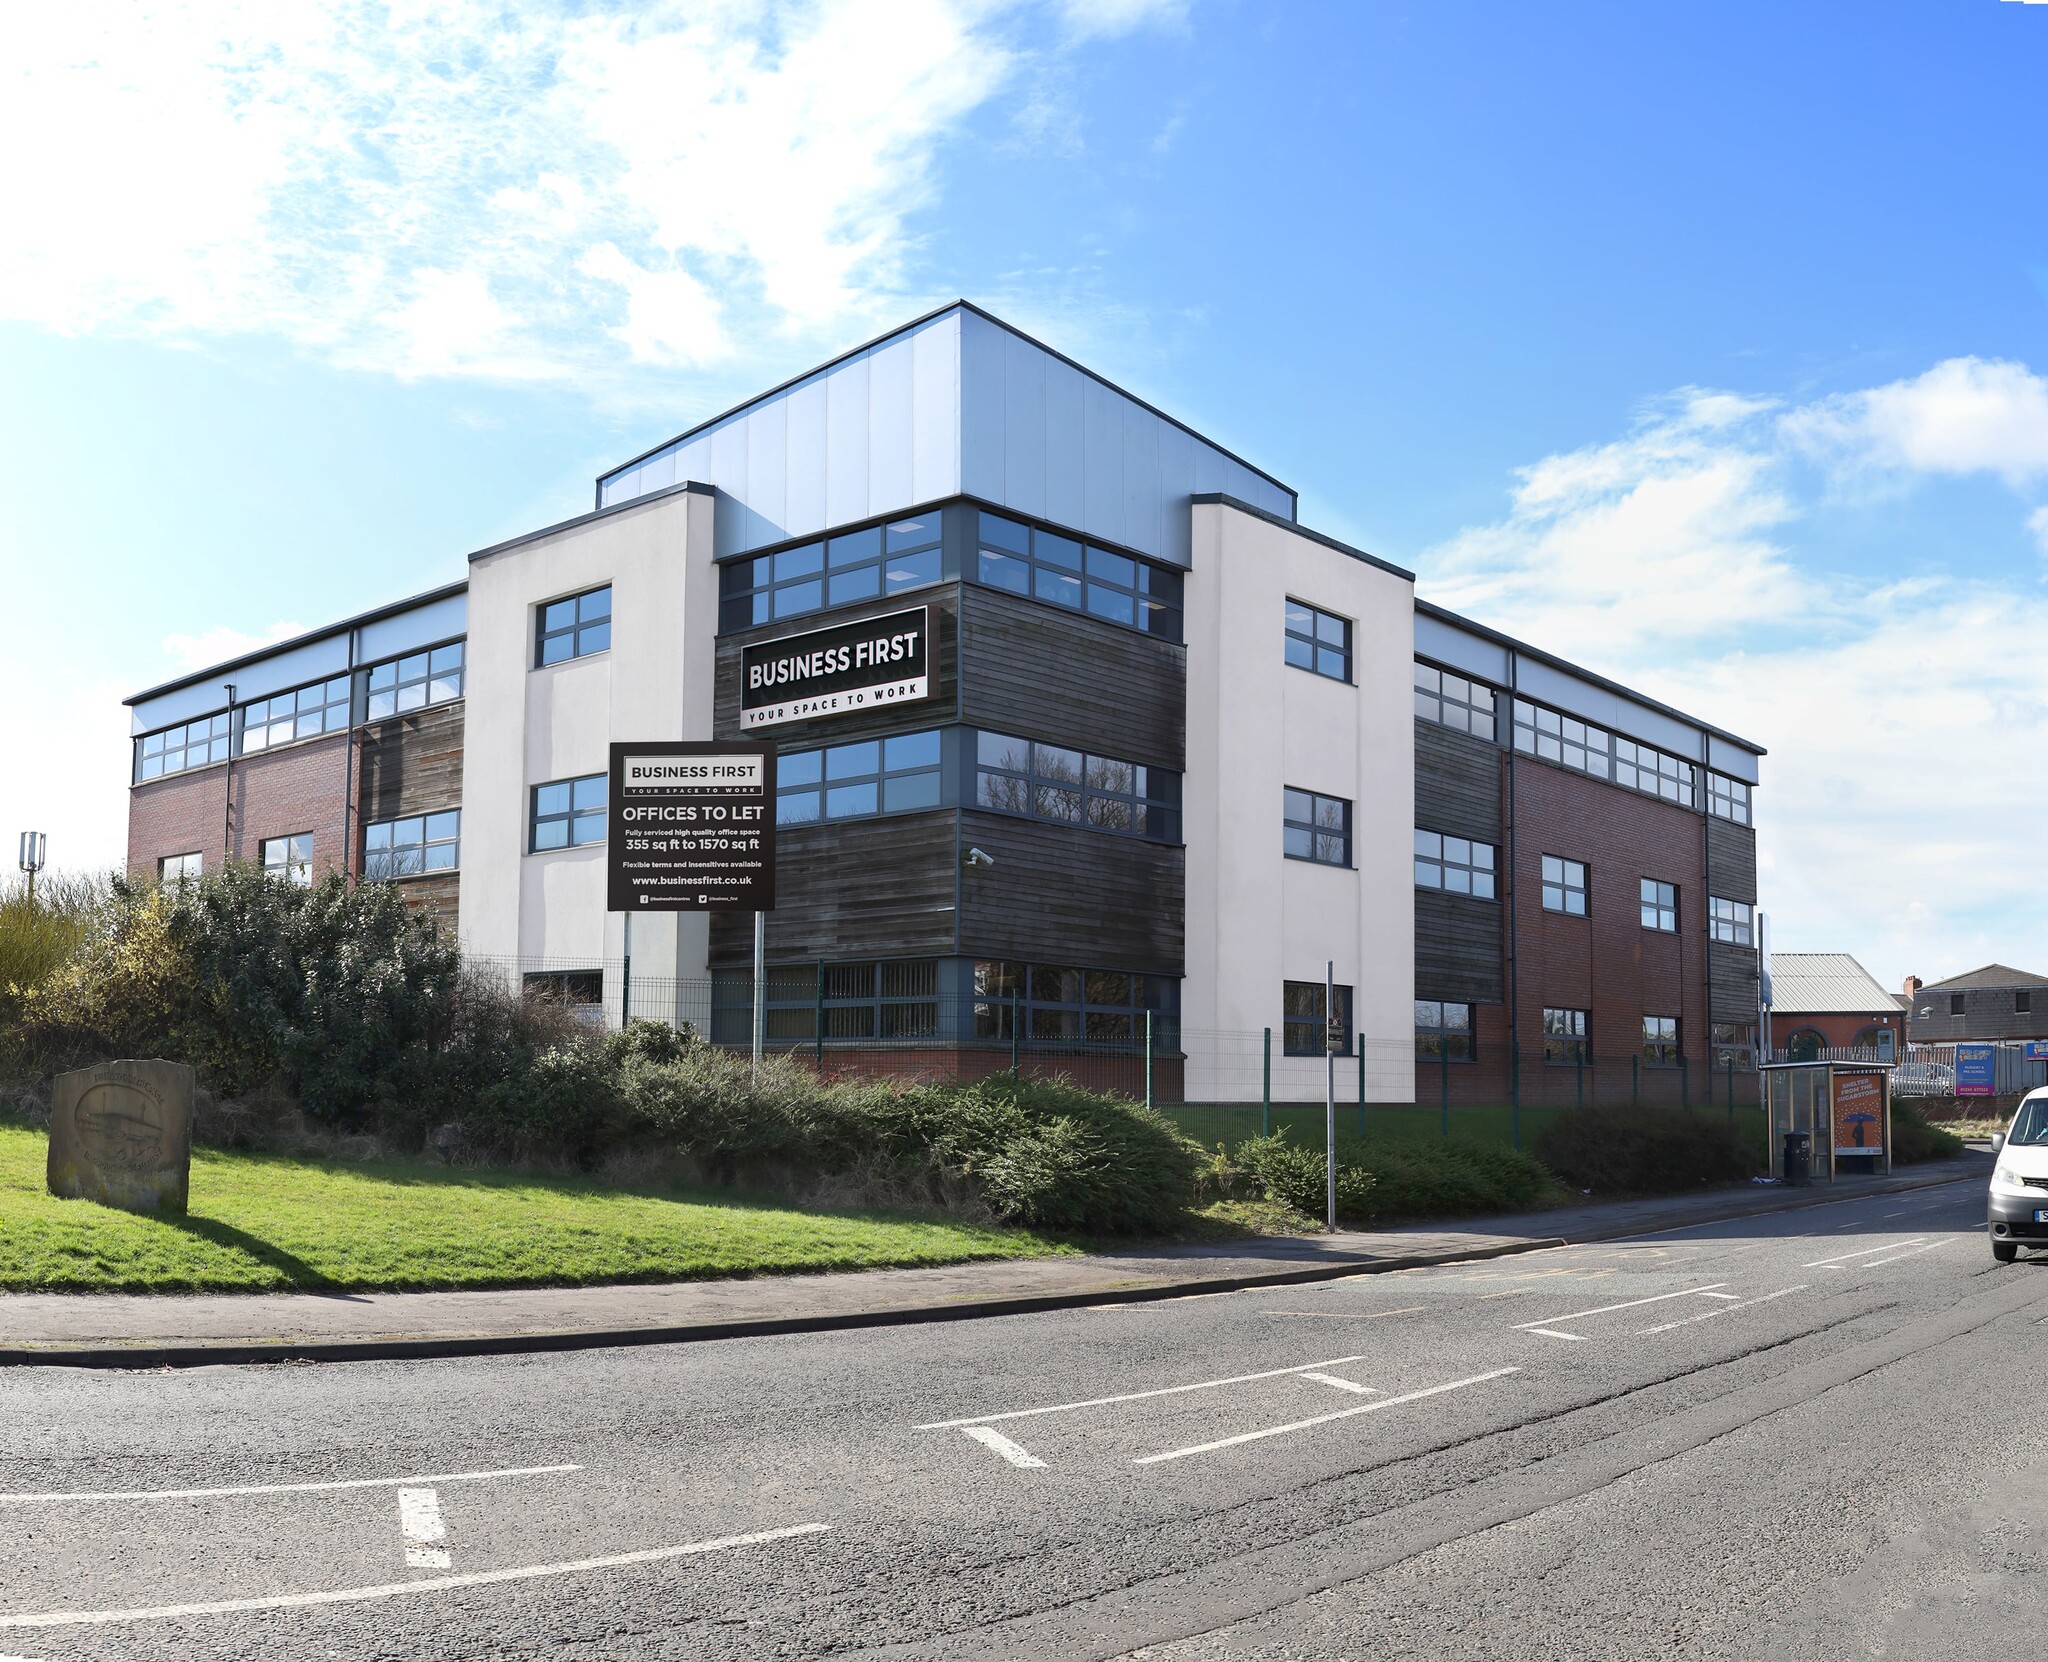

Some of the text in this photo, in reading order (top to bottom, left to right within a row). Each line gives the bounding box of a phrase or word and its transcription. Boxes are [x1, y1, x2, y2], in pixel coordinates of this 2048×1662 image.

[750, 632, 917, 689] BUSINESS FIRST
[750, 684, 916, 722] YOUR SPACE TO WORK
[632, 766, 755, 778] BUSINESS FIRST
[623, 806, 764, 820] OFFICES TO LET
[626, 839, 759, 852] 355 sq ft to 1570 sq ft
[632, 876, 752, 885] www.businessfirst.co.uk
[1842, 1079, 1869, 1089] SHELTER
[1837, 1089, 1879, 1102] SUGARSTORM
[1841, 1087, 1859, 1095] FROM
